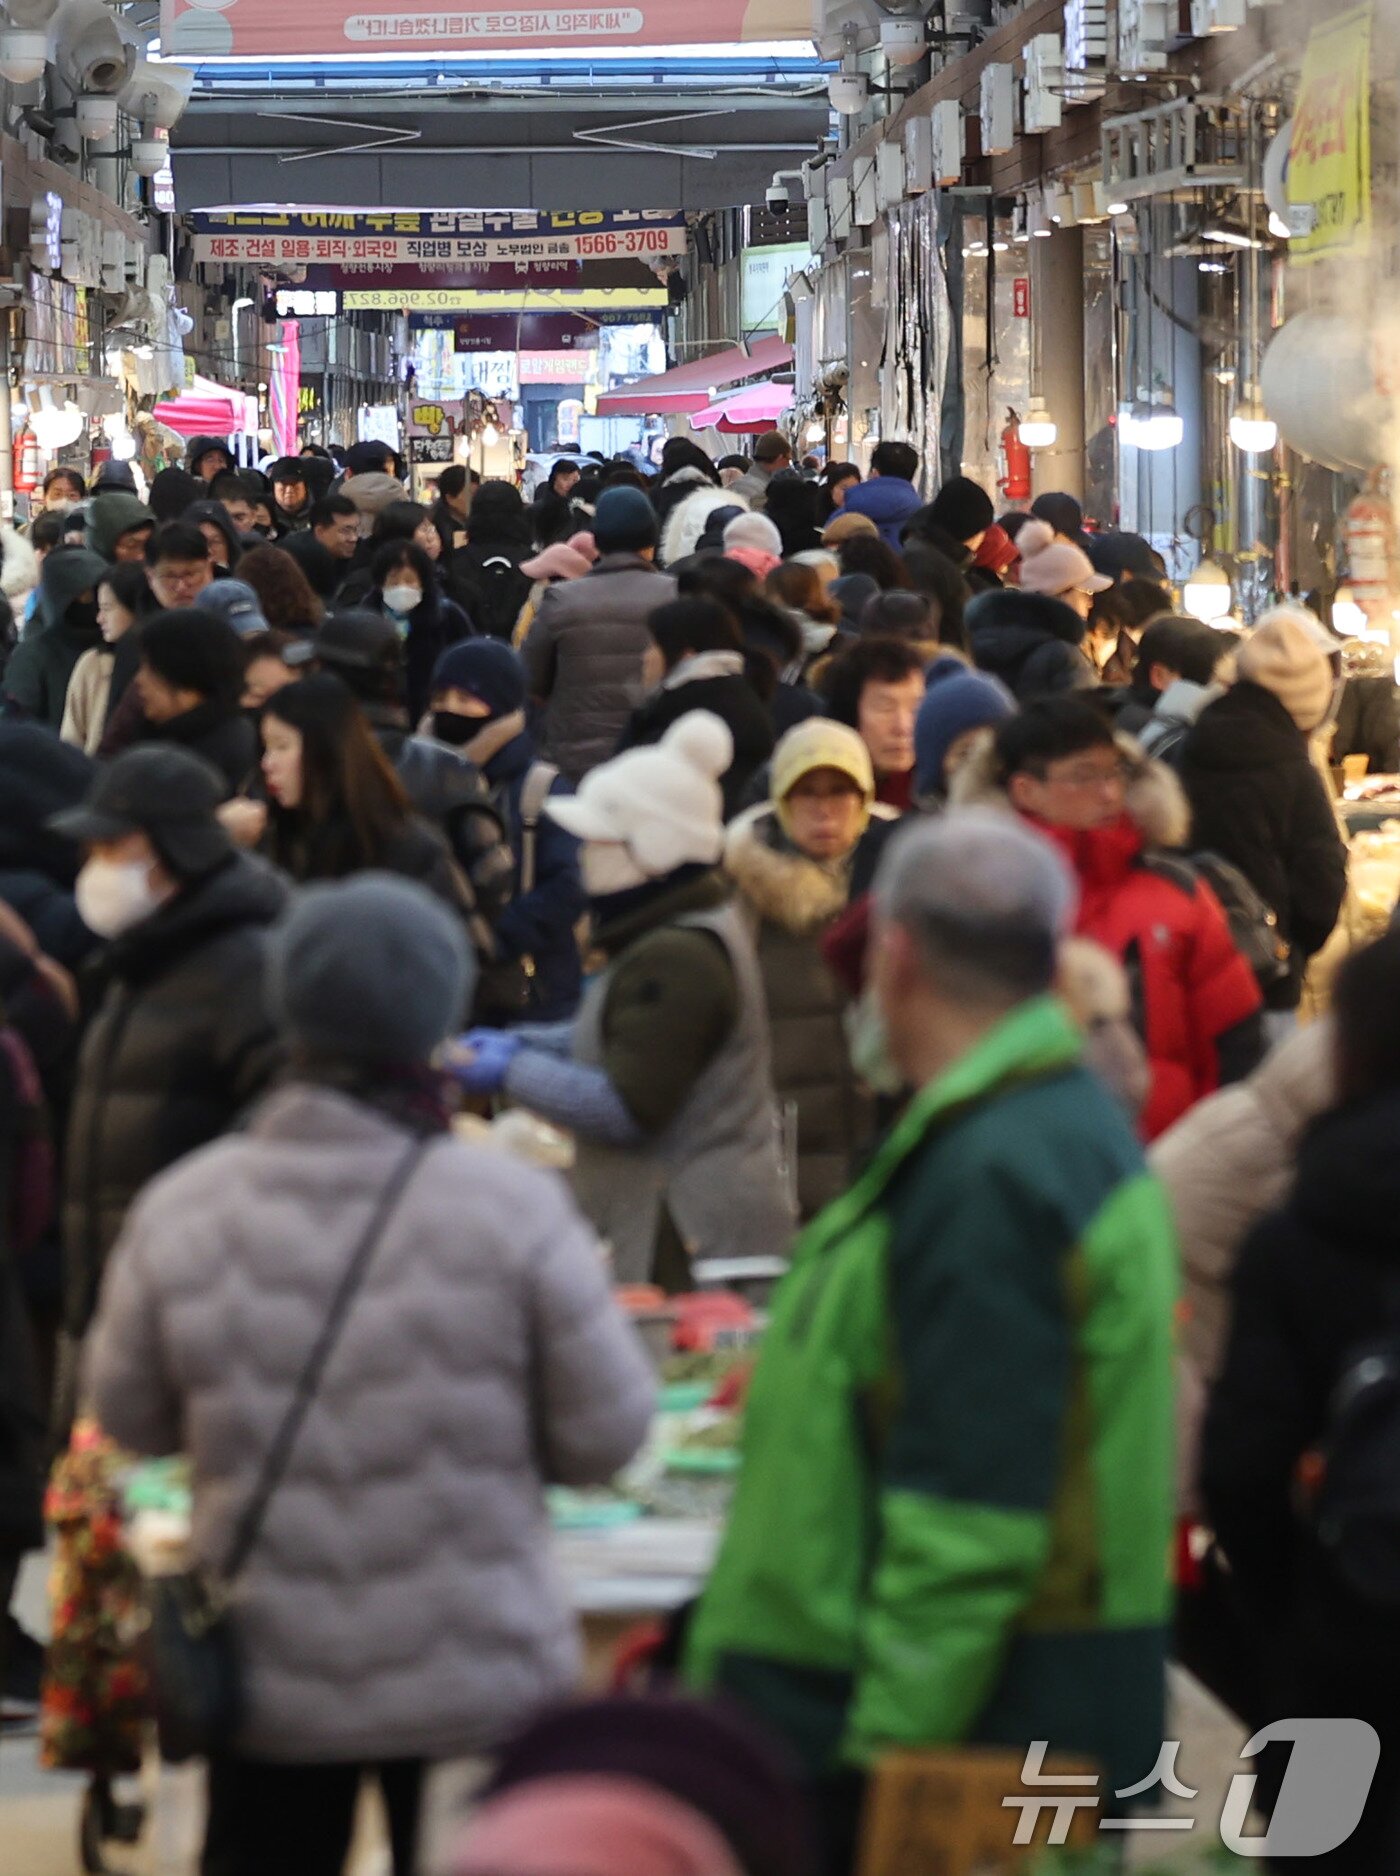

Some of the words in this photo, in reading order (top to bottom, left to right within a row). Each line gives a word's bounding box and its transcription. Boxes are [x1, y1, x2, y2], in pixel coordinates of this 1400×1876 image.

[210, 239, 276, 257] 제조·건설
[407, 240, 451, 258] 직업병
[457, 240, 488, 258] 보상
[496, 242, 545, 256] 노무법인
[574, 230, 669, 254] 1566-3709
